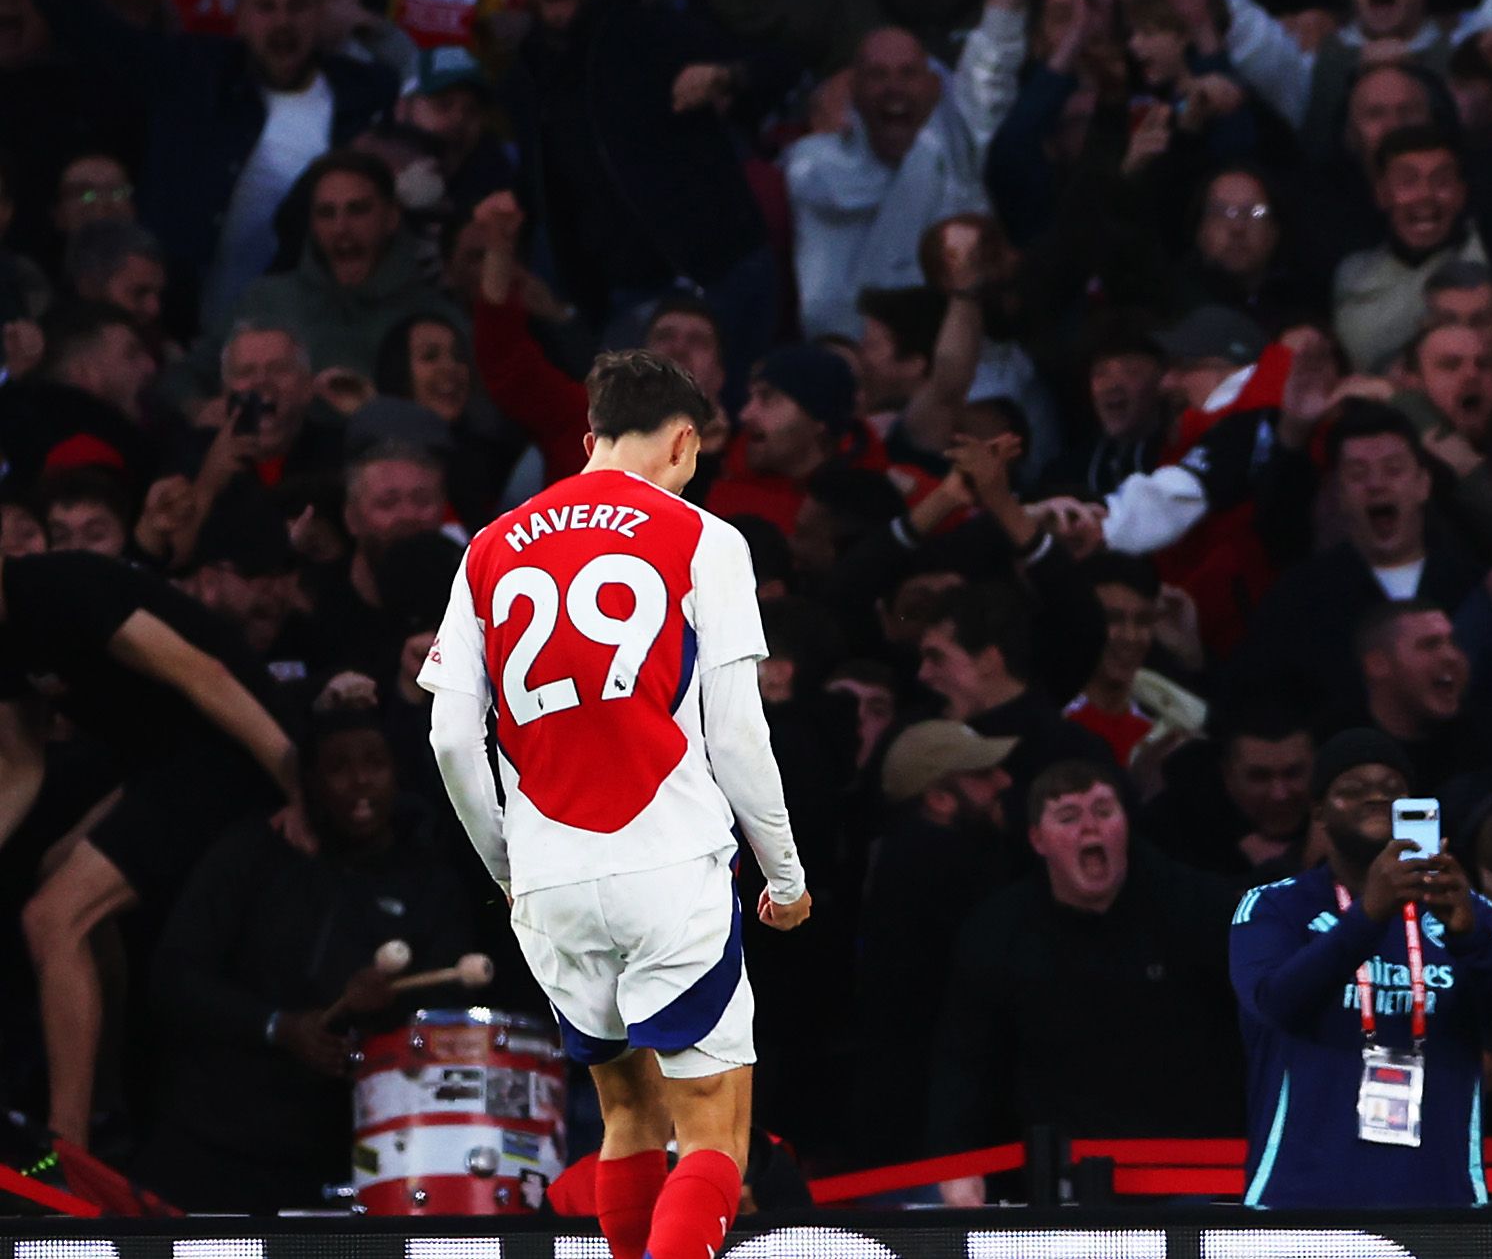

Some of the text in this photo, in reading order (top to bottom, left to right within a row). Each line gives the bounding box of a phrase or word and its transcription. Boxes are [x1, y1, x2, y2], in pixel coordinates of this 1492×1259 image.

[505, 504, 650, 552] HAVERTZ
[492, 554, 668, 726] 29
[1363, 955, 1455, 988] iraes
